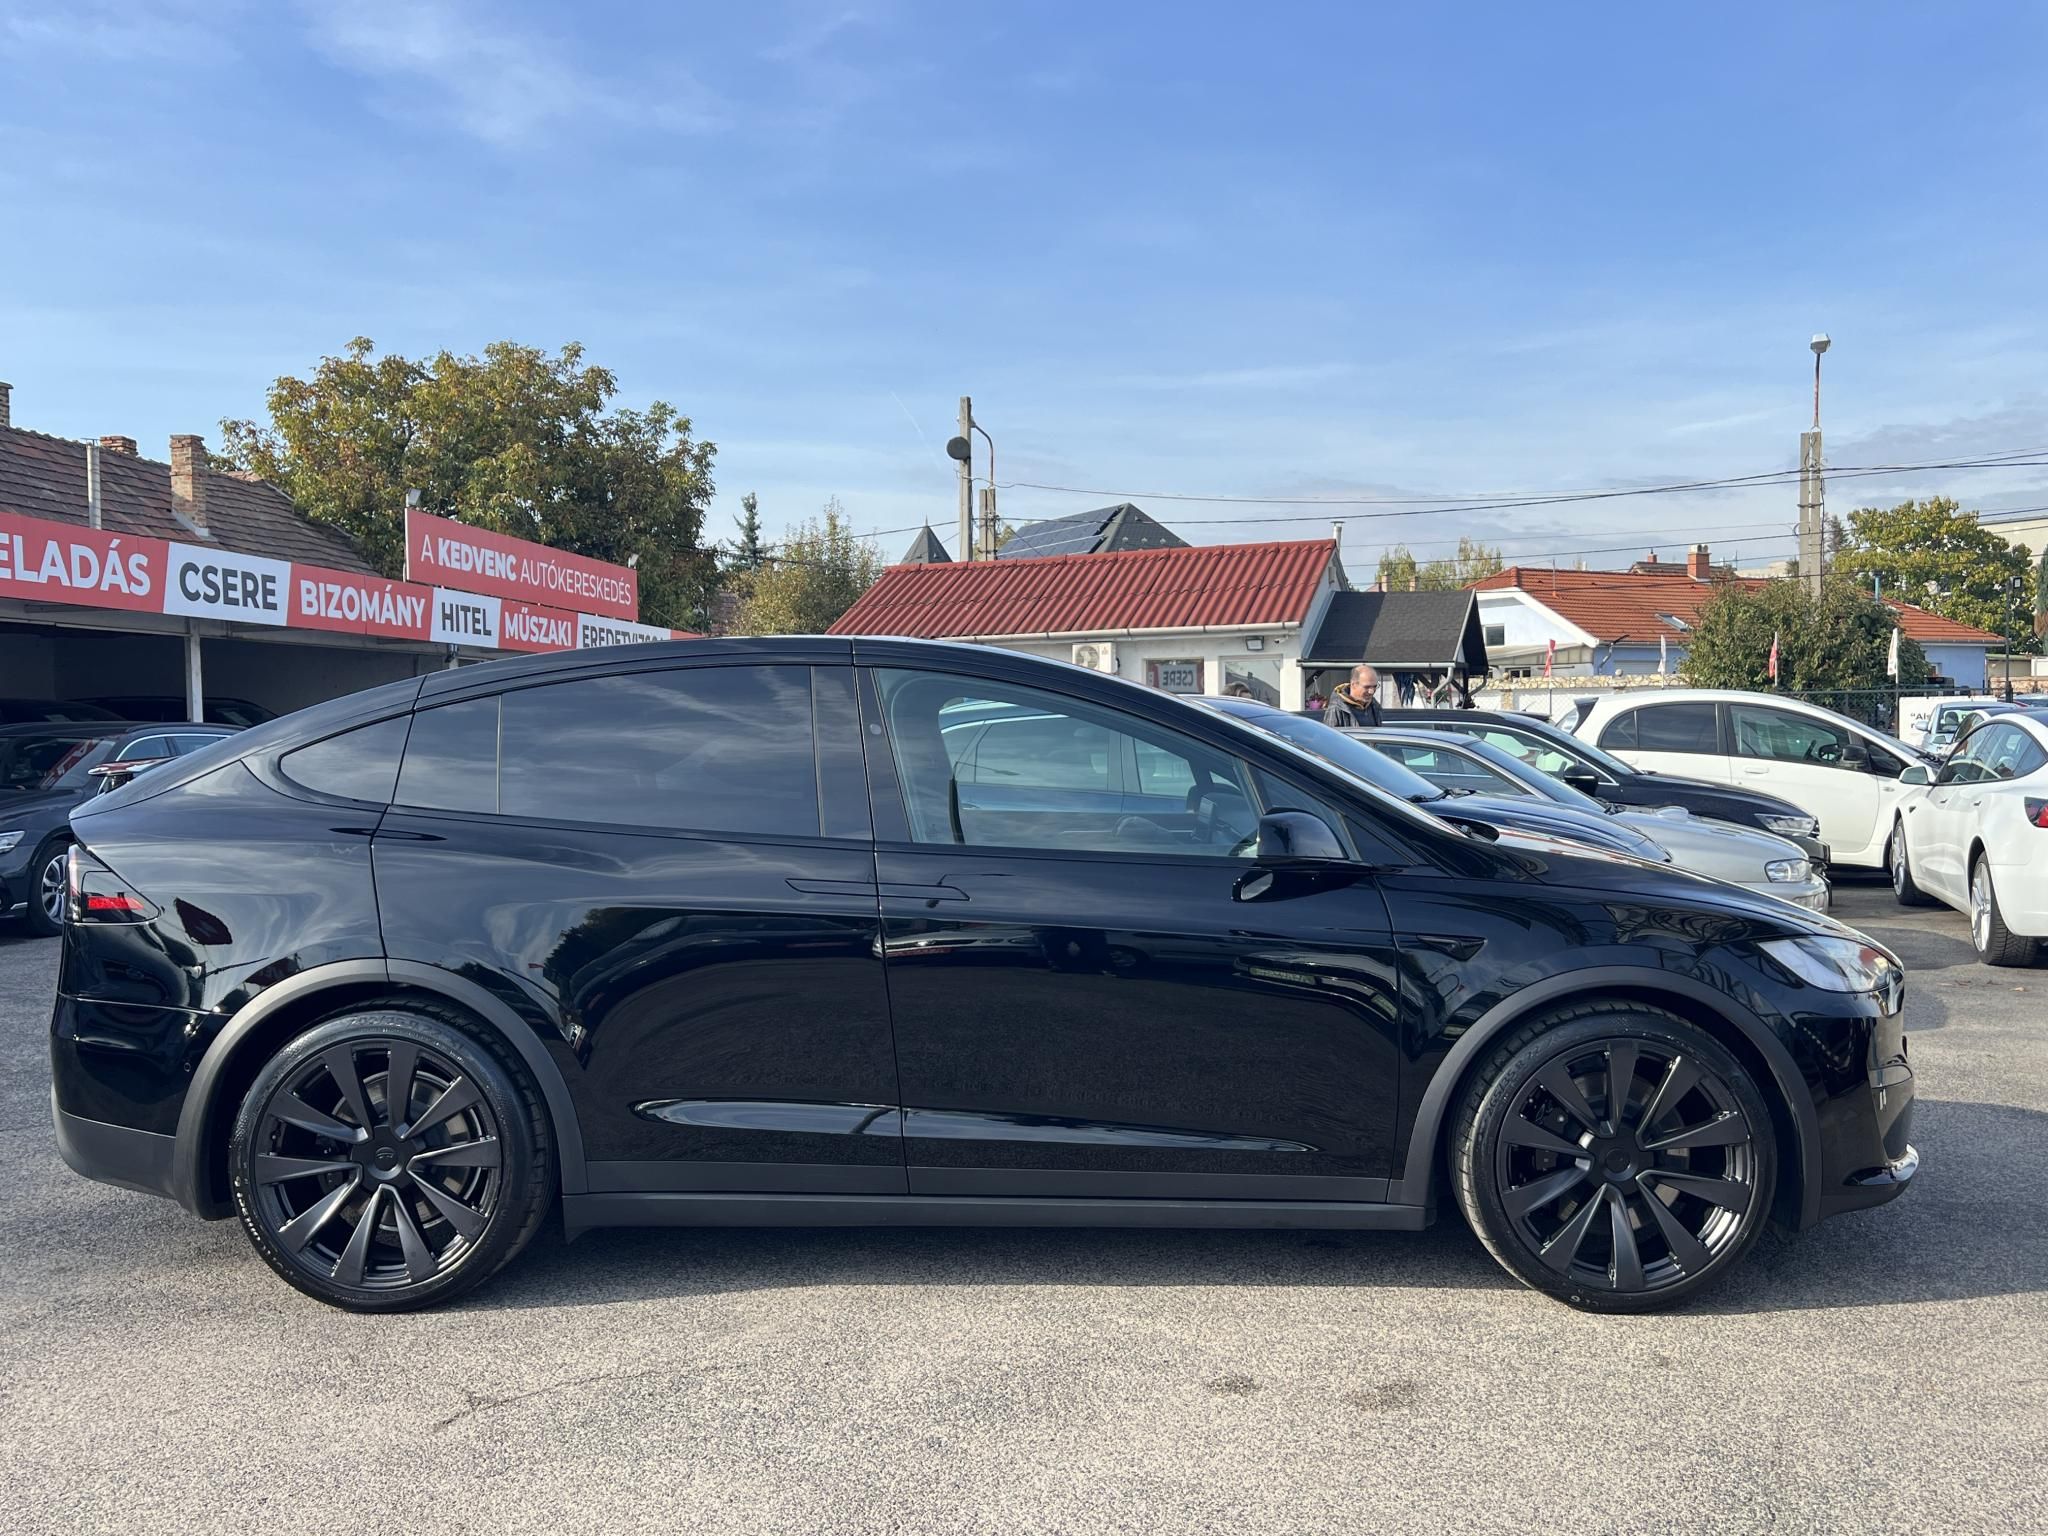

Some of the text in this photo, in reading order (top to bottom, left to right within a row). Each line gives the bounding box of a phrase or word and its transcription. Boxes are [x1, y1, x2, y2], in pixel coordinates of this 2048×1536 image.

[179, 562, 278, 611] CSERE
[300, 579, 425, 628] BIZOMÁNY
[441, 602, 492, 636] HITEL
[505, 607, 572, 647] MŰSZAKI
[421, 534, 631, 606] A KEDVENC AUTÓKERESKEDÉS
